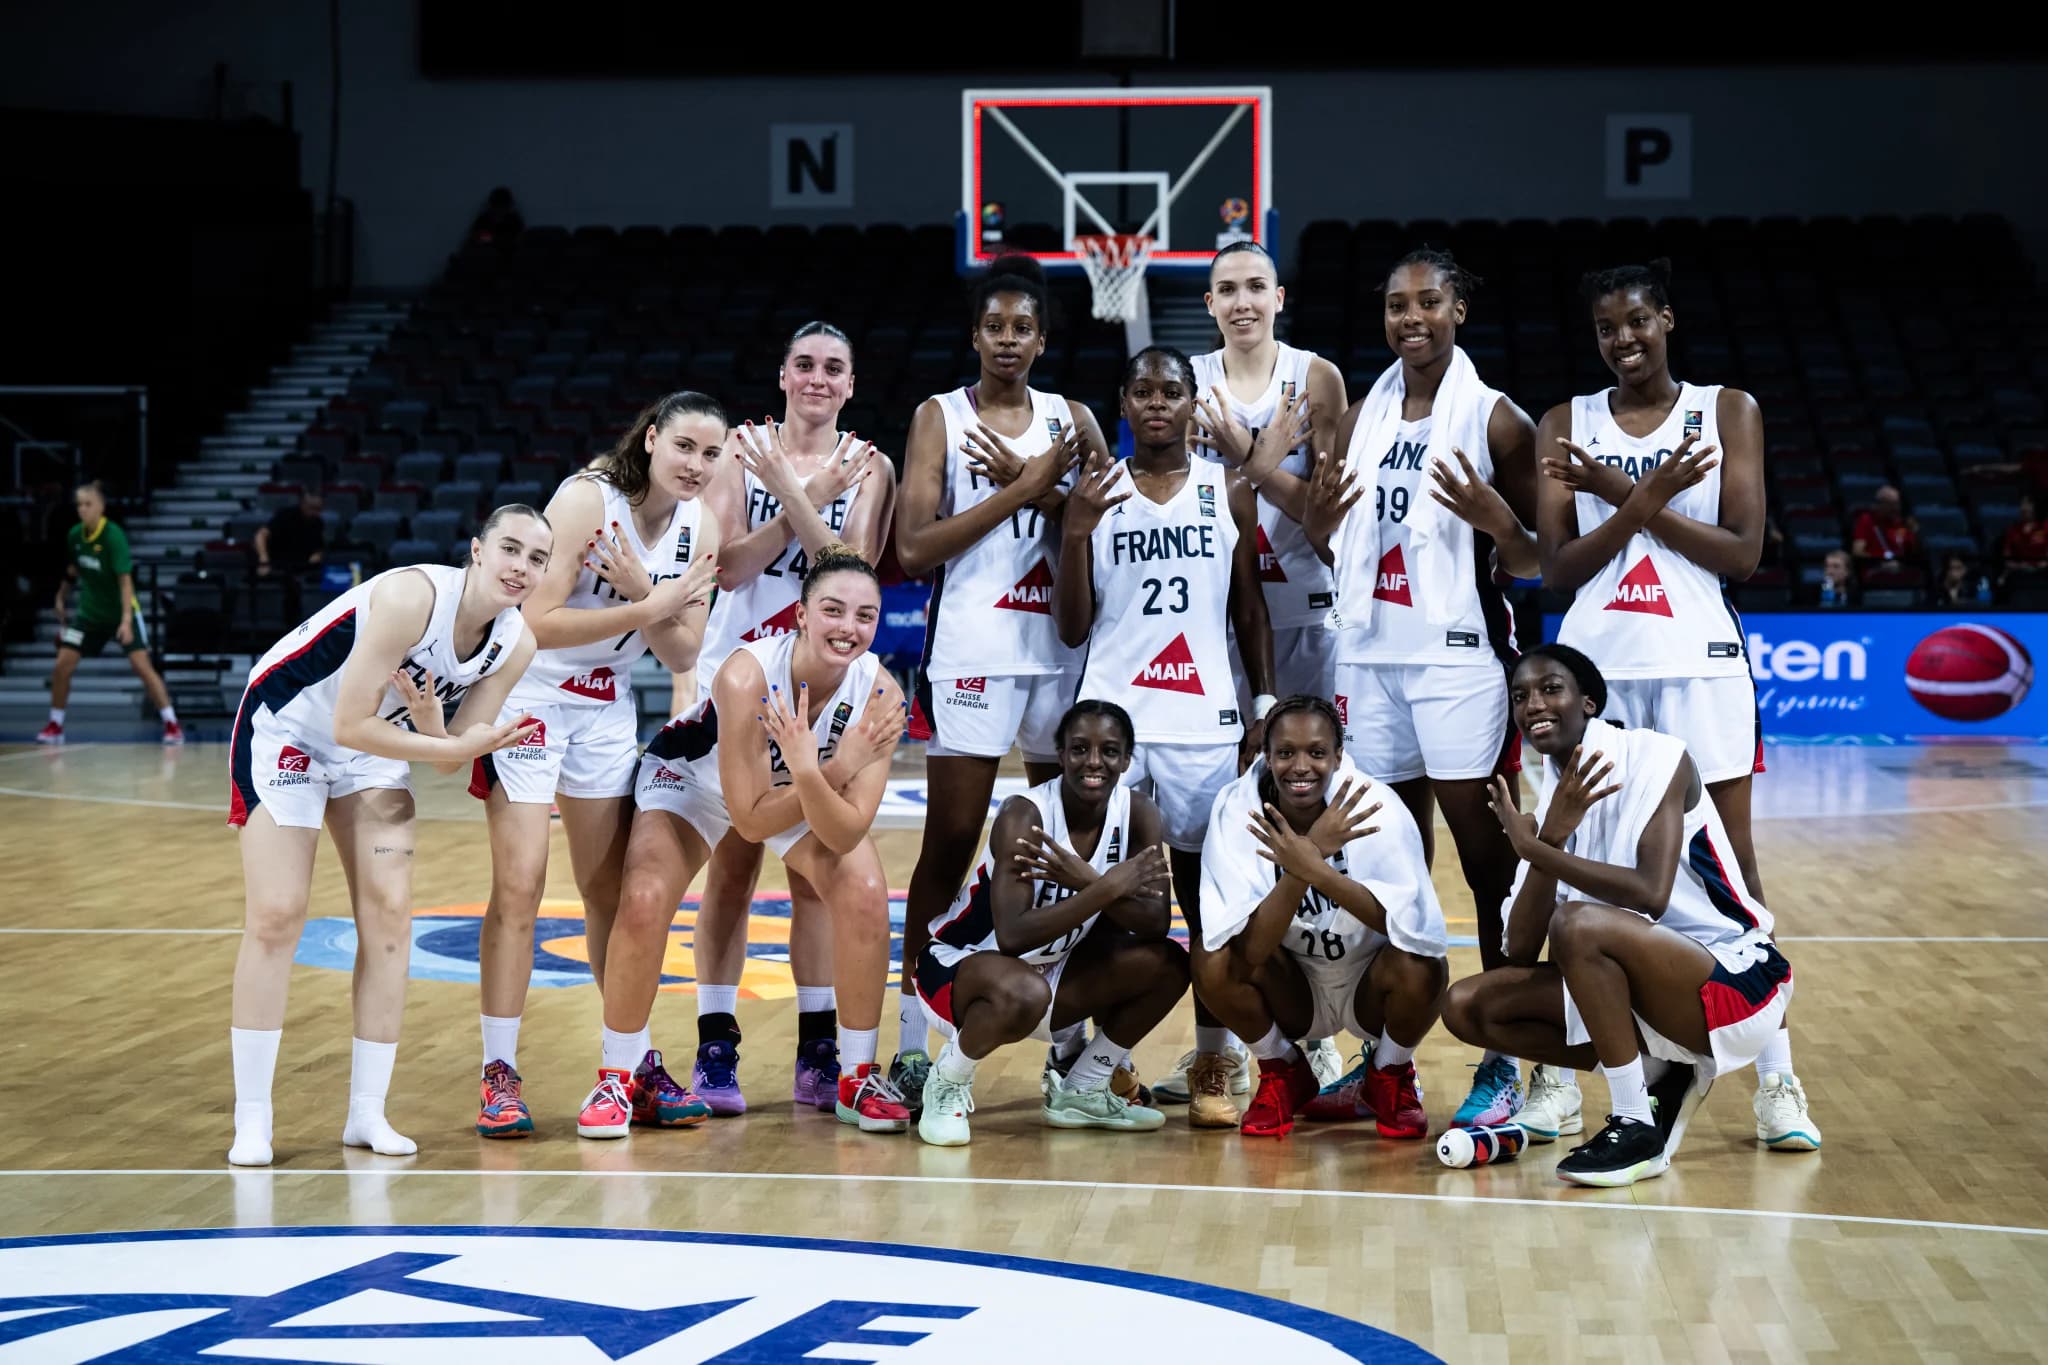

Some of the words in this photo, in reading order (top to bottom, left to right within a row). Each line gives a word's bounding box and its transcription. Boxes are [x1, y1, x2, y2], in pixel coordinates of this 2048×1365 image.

[788, 136, 837, 194] N
[1625, 127, 1671, 185] P
[1012, 503, 1041, 539] 17
[1113, 525, 1215, 566] FRANCE
[1377, 572, 1409, 591] AIF
[1612, 585, 1668, 603] MAIF
[1142, 576, 1189, 616] 23
[1143, 663, 1197, 681] MAIF
[946, 697, 990, 710] D'EPARGNE
[956, 691, 981, 702] CAISSE
